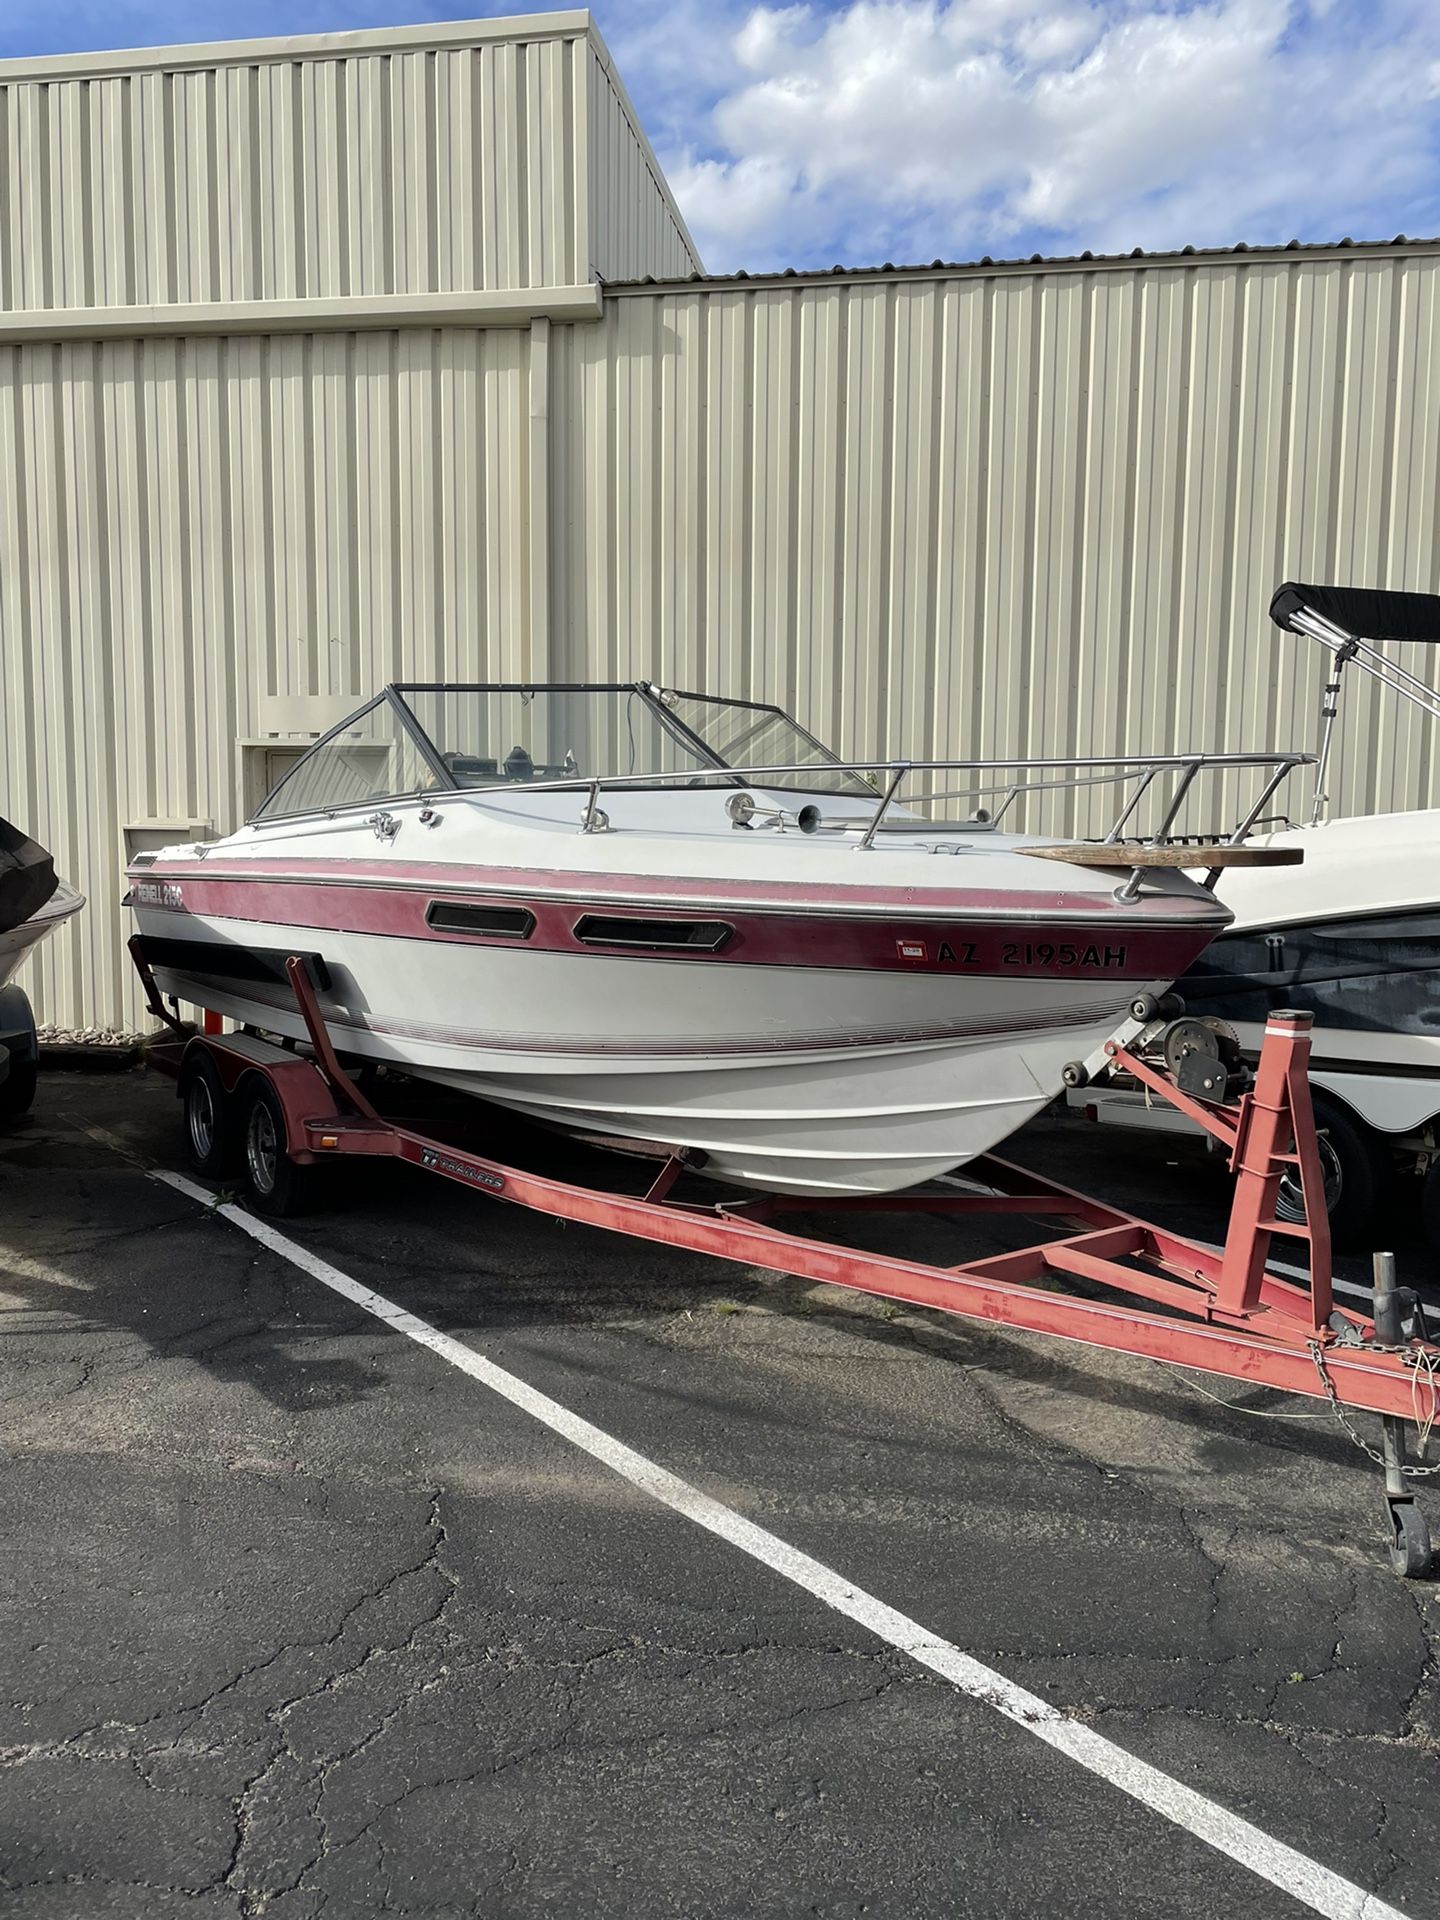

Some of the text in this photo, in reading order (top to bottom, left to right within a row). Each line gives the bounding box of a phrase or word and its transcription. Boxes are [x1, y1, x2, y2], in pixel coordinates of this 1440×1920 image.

[937, 942, 1127, 968] AZ 2195AH
[440, 1157, 503, 1188] TRAILERS
